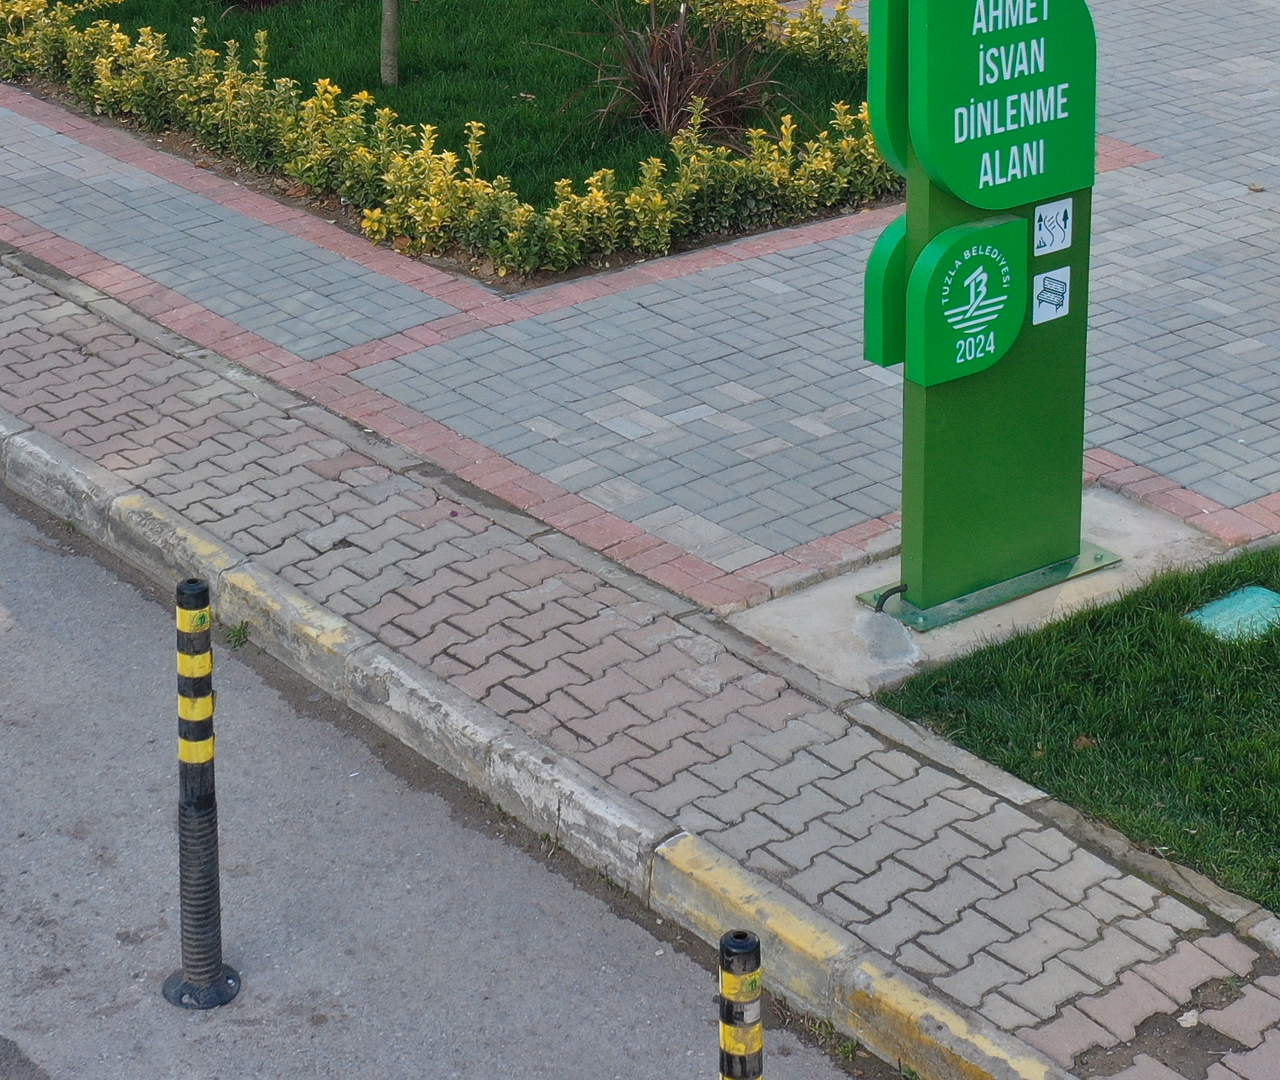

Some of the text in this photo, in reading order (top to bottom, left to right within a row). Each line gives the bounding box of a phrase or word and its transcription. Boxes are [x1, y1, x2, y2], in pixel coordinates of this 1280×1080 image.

[978, 37, 1045, 86] İSVAN
[954, 83, 1070, 144] DİNLENME
[978, 139, 1045, 190] ALANI
[941, 244, 1011, 306] TUZLA BELEDİYESİ
[955, 331, 996, 364] 2024
